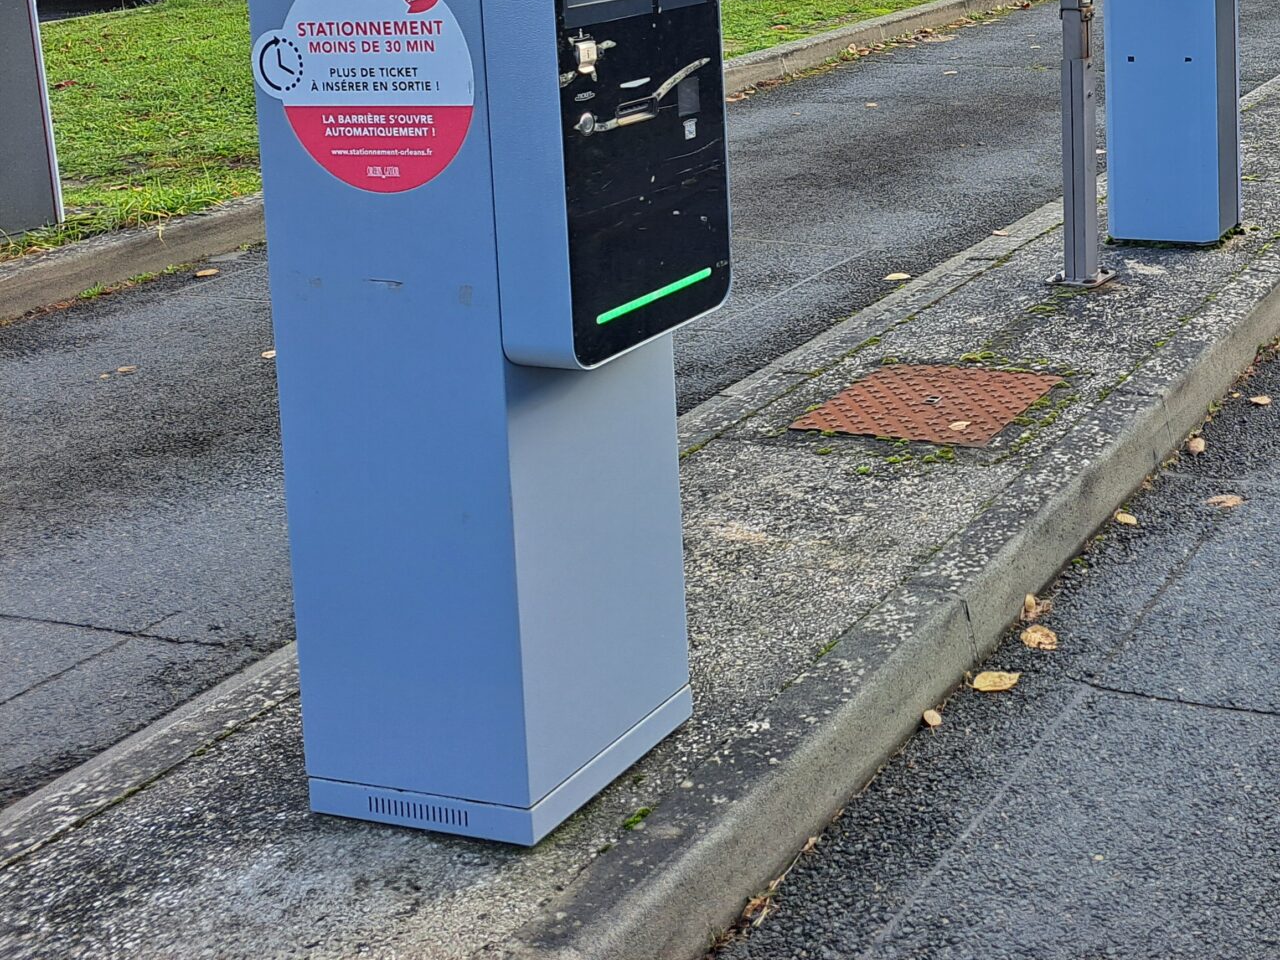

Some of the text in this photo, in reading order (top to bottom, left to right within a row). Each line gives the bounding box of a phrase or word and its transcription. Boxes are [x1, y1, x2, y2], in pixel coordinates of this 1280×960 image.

[297, 20, 443, 37] STATIONNEMENT
[308, 40, 435, 54] MOINS DE 30 MIN
[329, 67, 418, 78] PLUS DE TICKET
[311, 79, 439, 91] À INSÉRER EN SORTIE !
[322, 113, 433, 124] LA BARRIÈRE S'OUVRE
[325, 127, 436, 137] AUTOMATIQUEMENT !
[331, 148, 433, 156] www.stationnement-orleans.fr
